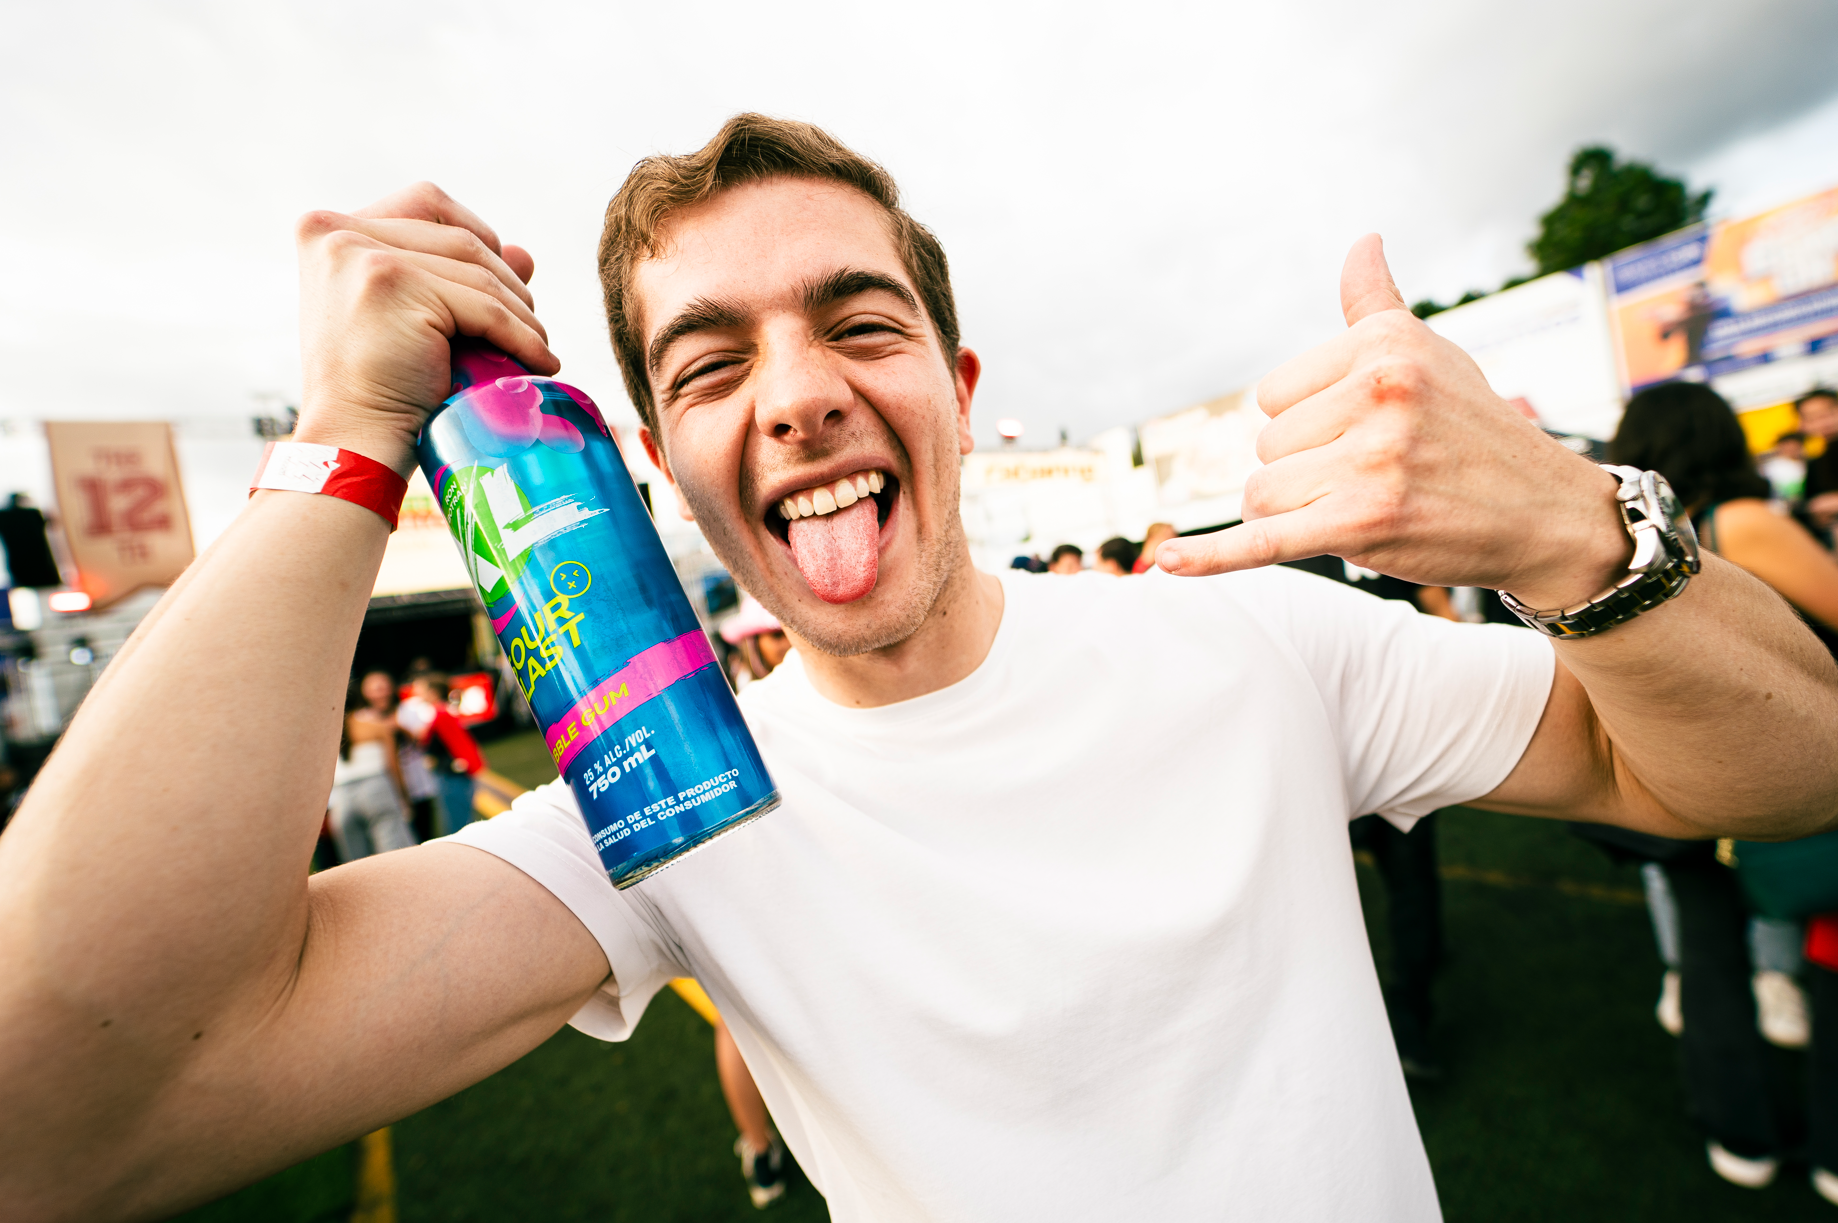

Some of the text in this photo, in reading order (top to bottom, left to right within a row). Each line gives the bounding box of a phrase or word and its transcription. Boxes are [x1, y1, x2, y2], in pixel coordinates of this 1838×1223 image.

[76, 474, 172, 538] 12
[445, 481, 457, 505] RON
[518, 612, 585, 704] LAST
[581, 682, 630, 726] GUM
[583, 726, 655, 786] 25 % ALC./VOL.
[588, 744, 656, 800] 750 mL
[604, 829, 631, 847] SALUD
[632, 818, 656, 832] DEL
[657, 780, 738, 821] CONSUMIDOR
[626, 811, 643, 824] DE
[643, 796, 676, 816] ESTE
[678, 768, 739, 801] PRODUCTO
